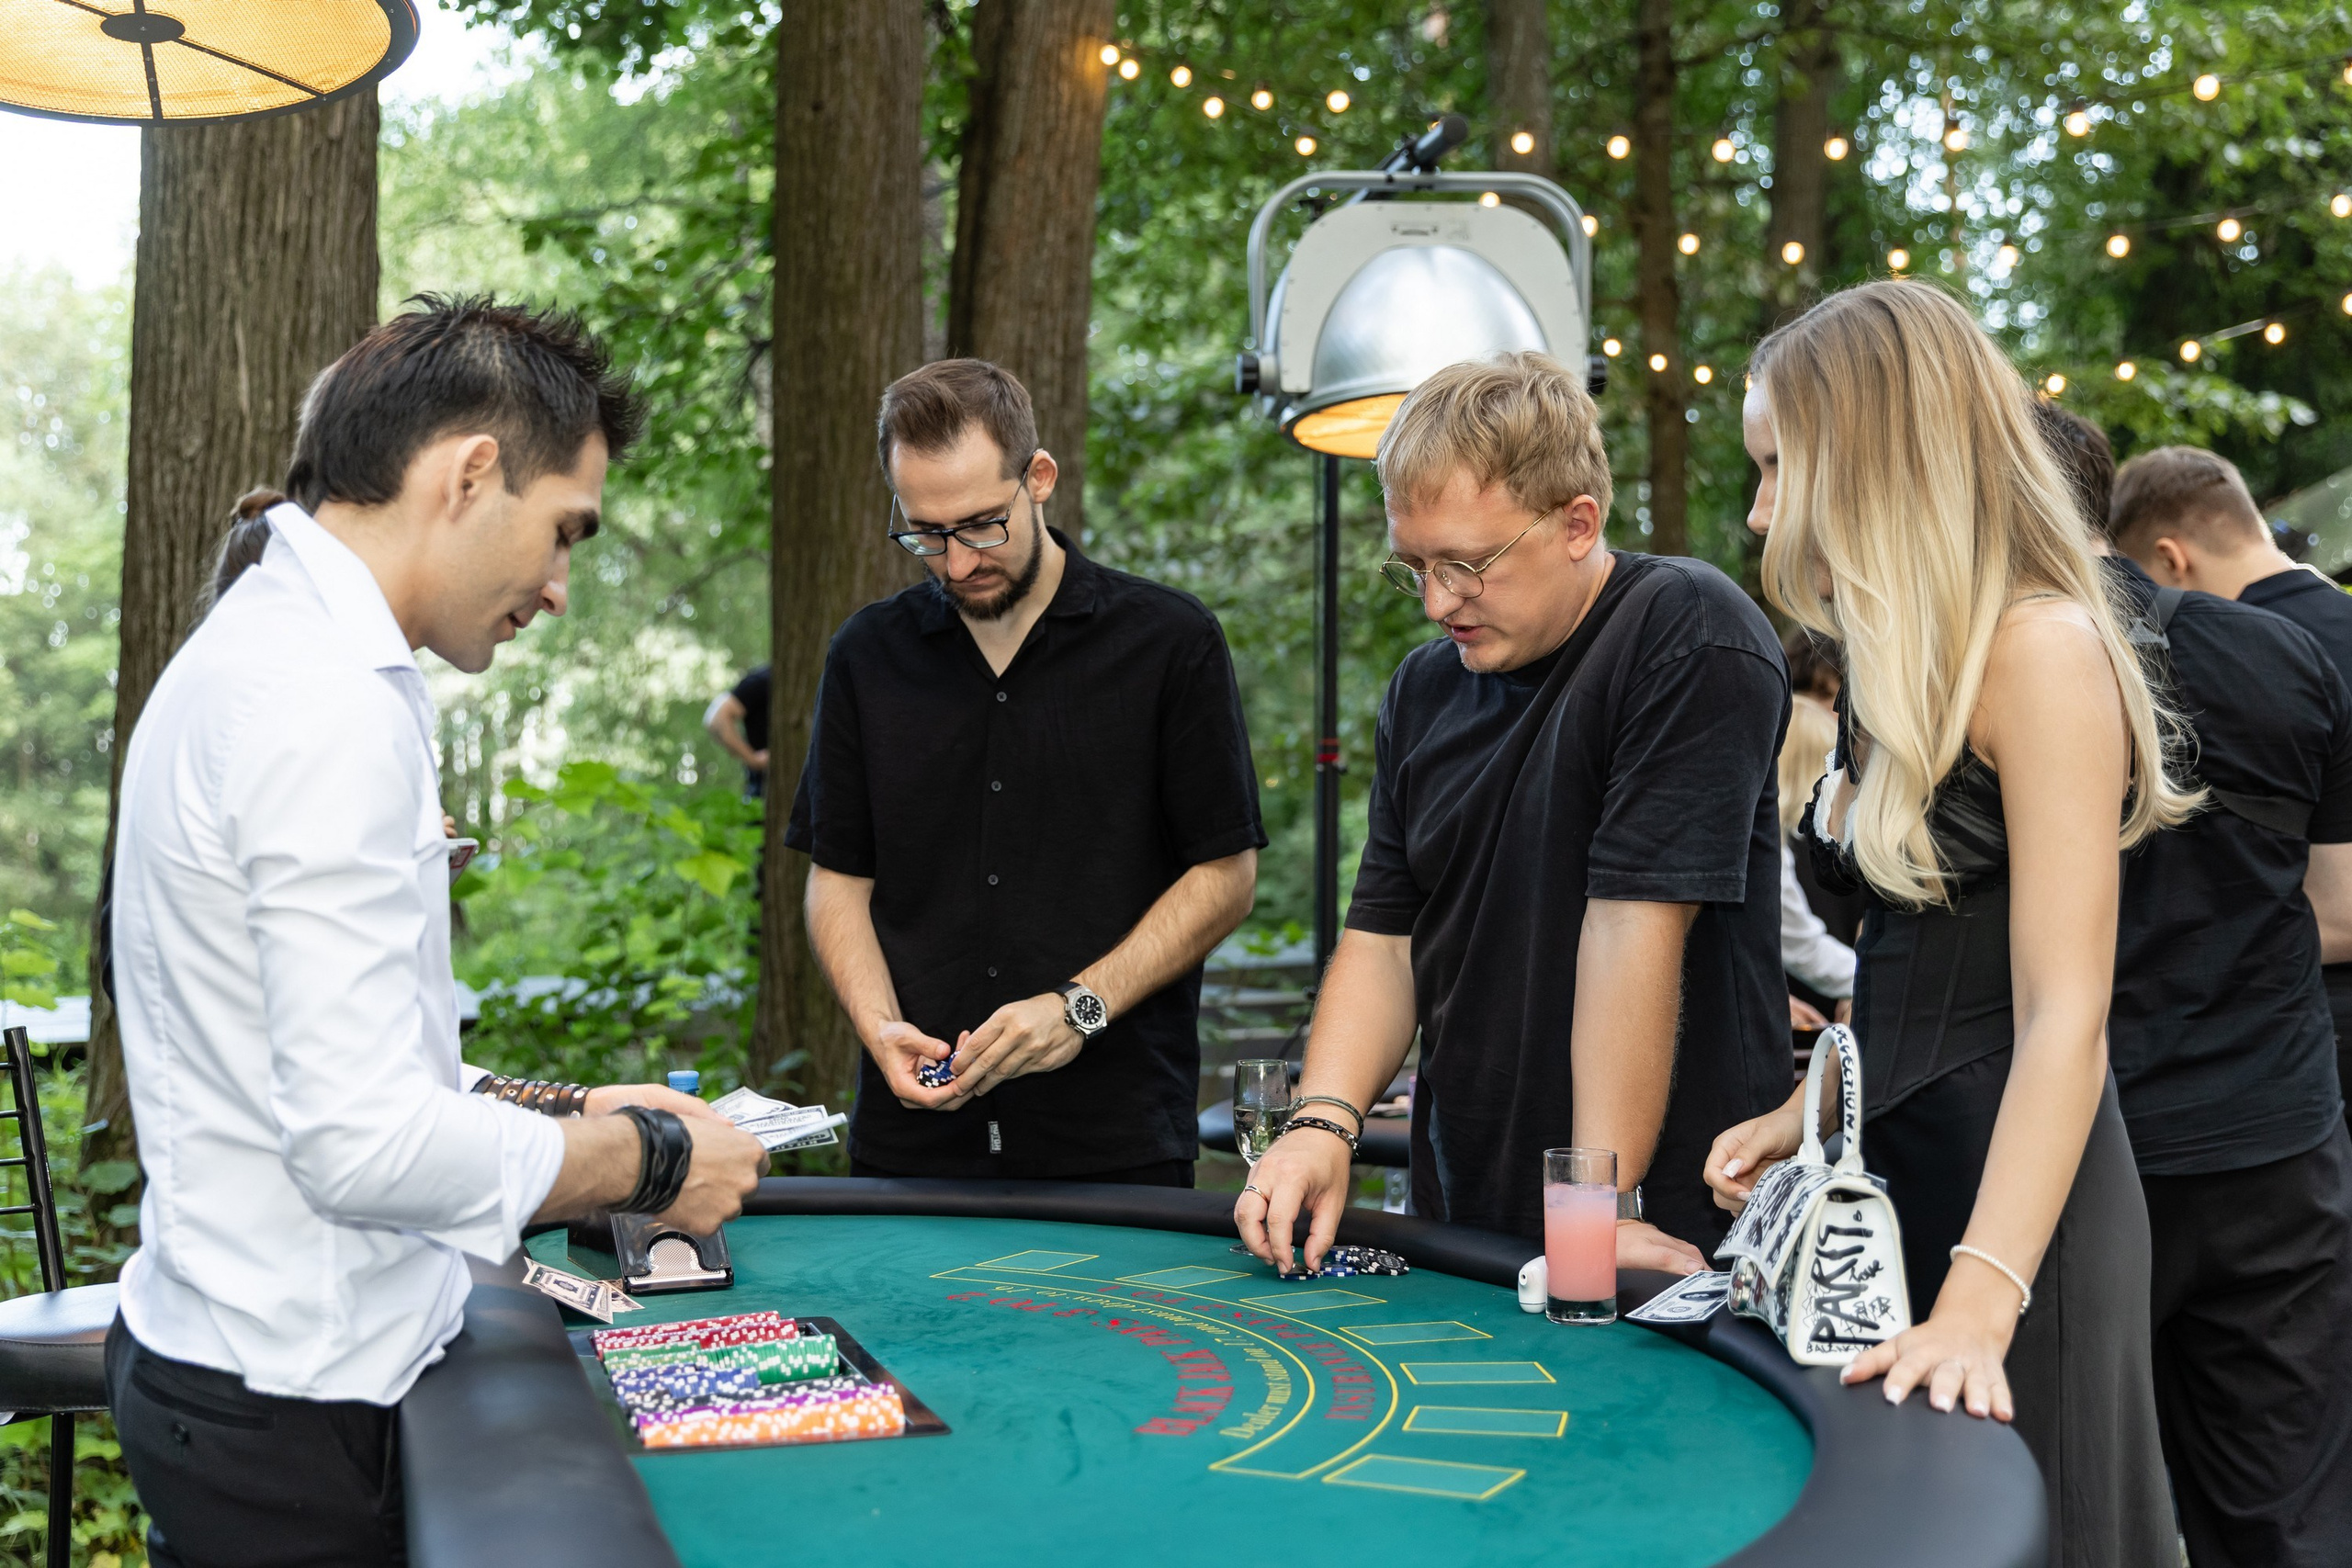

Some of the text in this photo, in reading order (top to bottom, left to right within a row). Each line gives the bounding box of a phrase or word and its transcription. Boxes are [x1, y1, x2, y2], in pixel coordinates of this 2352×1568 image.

[992, 1285, 1031, 1293] 16
[1074, 1295, 1136, 1308] draw
[1131, 1308, 1193, 1322] must
[1174, 1322, 1231, 1335] and
[1098, 1284, 1376, 1420] INSURANCE PAYS 2 TO 1
[1243, 1348, 1272, 1359] on
[946, 1291, 1235, 1437] BLACK JACK PAYS 3 TO 2
[1245, 1359, 1291, 1382] stand
[1265, 1382, 1292, 1404] must
[1218, 1404, 1283, 1439] Dealer
